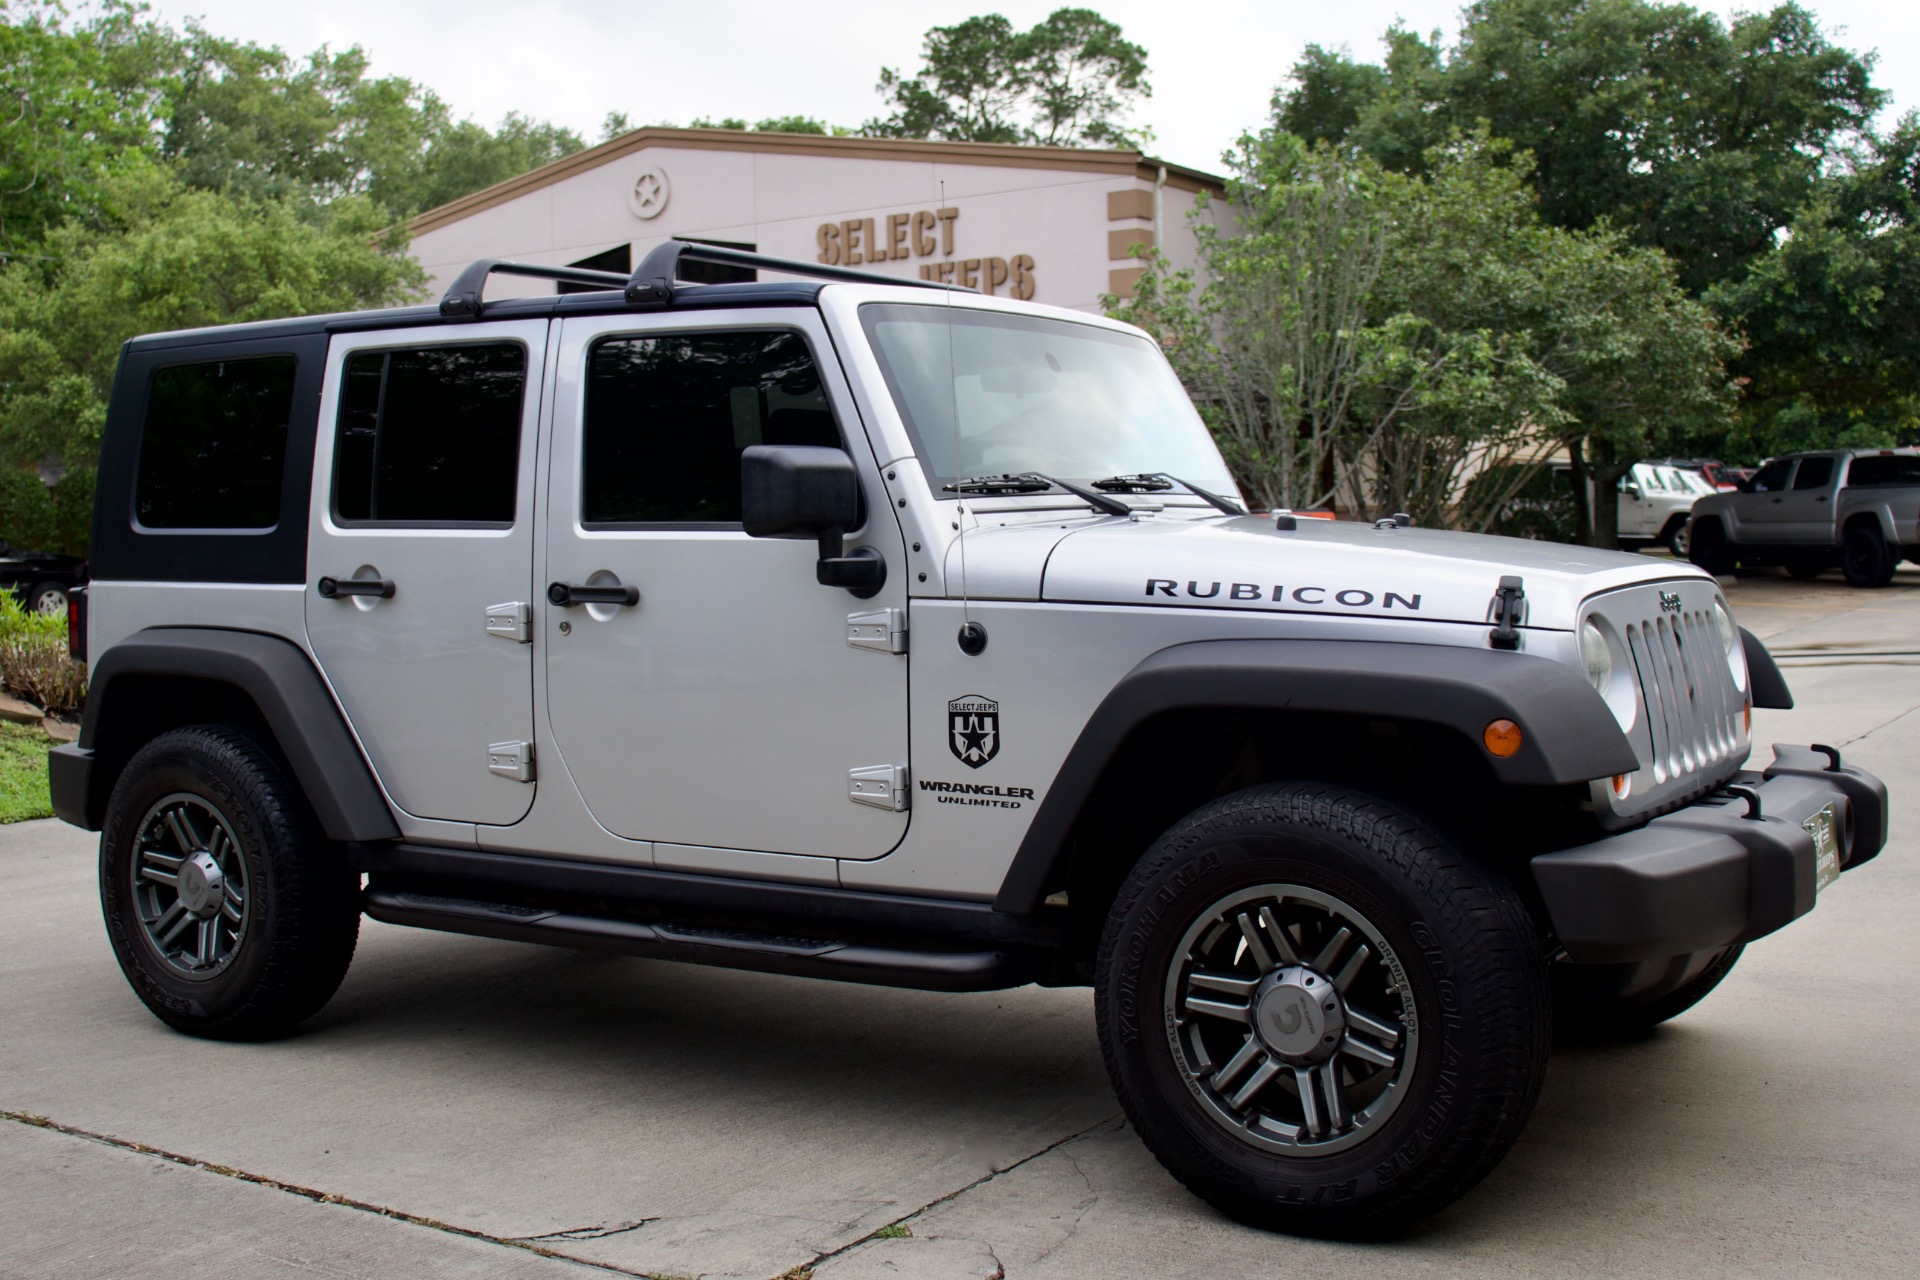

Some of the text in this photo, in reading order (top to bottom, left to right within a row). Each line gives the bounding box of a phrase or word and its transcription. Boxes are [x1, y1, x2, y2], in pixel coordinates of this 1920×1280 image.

[817, 206, 959, 266] SELECT
[1145, 578, 1422, 611] RUBICON
[1658, 590, 1682, 614] Jeep
[950, 703, 997, 712] SELECT JEEPS
[919, 780, 1035, 800] WRANGLER
[937, 795, 1022, 809] UNLIMITED
[1118, 851, 1223, 1048] YOKOHAMA
[1377, 940, 1409, 993] GRANITE
[1402, 995, 1417, 1038] ALLOY
[1166, 1005, 1202, 1097] GRANITE ALLOY
[1373, 919, 1463, 1186] GEOLANDAR
